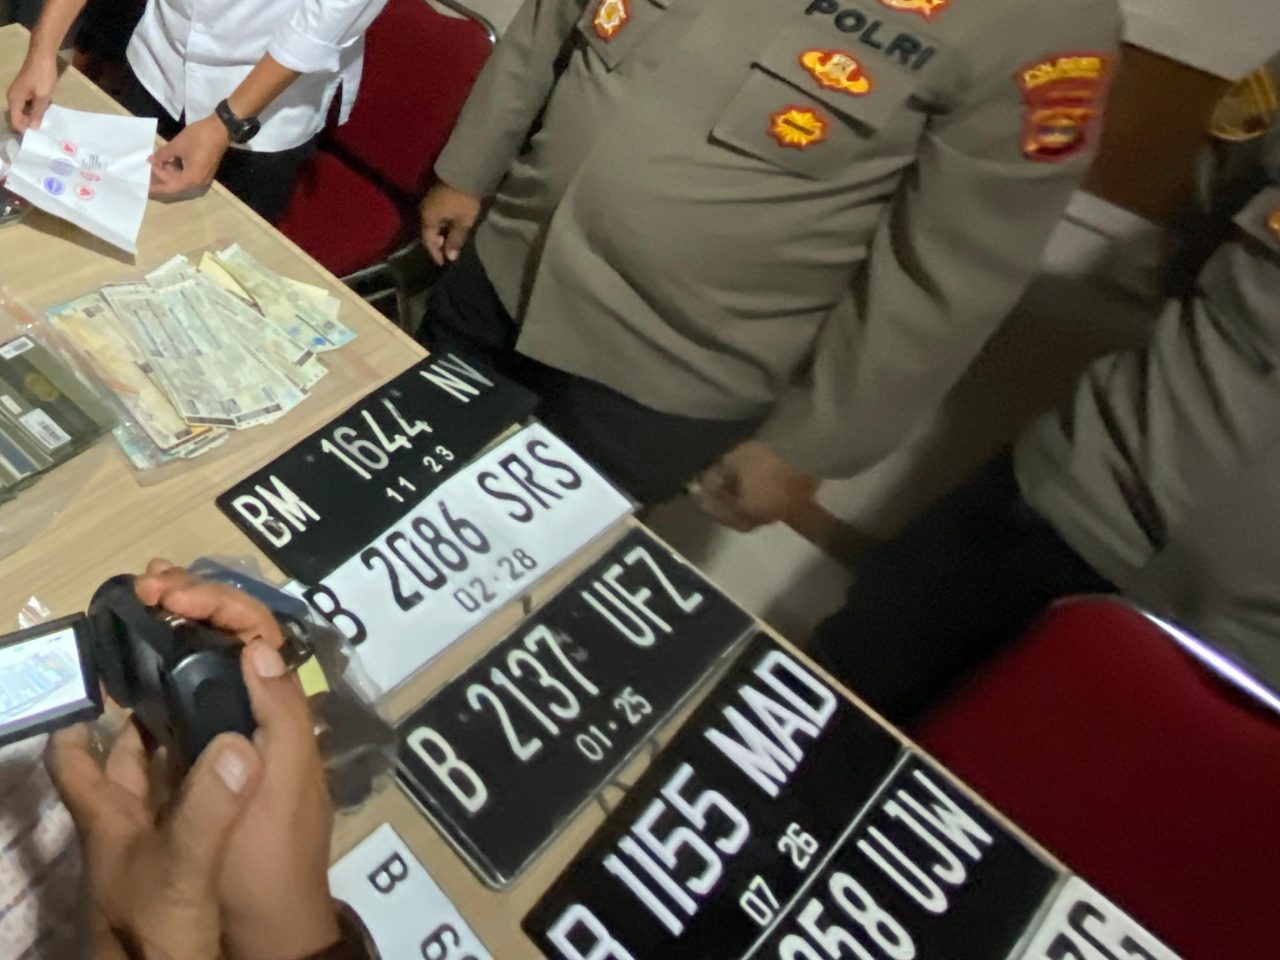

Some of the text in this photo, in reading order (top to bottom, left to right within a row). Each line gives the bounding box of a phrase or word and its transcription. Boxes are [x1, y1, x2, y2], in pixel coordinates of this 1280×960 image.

[231, 352, 495, 548] BM 1644 NV
[301, 438, 584, 647] B 2086 SRS
[386, 444, 455, 502] 11 23
[406, 545, 704, 815] B 2137 UFZ
[367, 851, 409, 894] B
[602, 761, 751, 938] 1155
[704, 649, 838, 798] MAD
[739, 821, 820, 926] 07 26
[778, 871, 916, 960] 58
[856, 769, 994, 915] UJW
